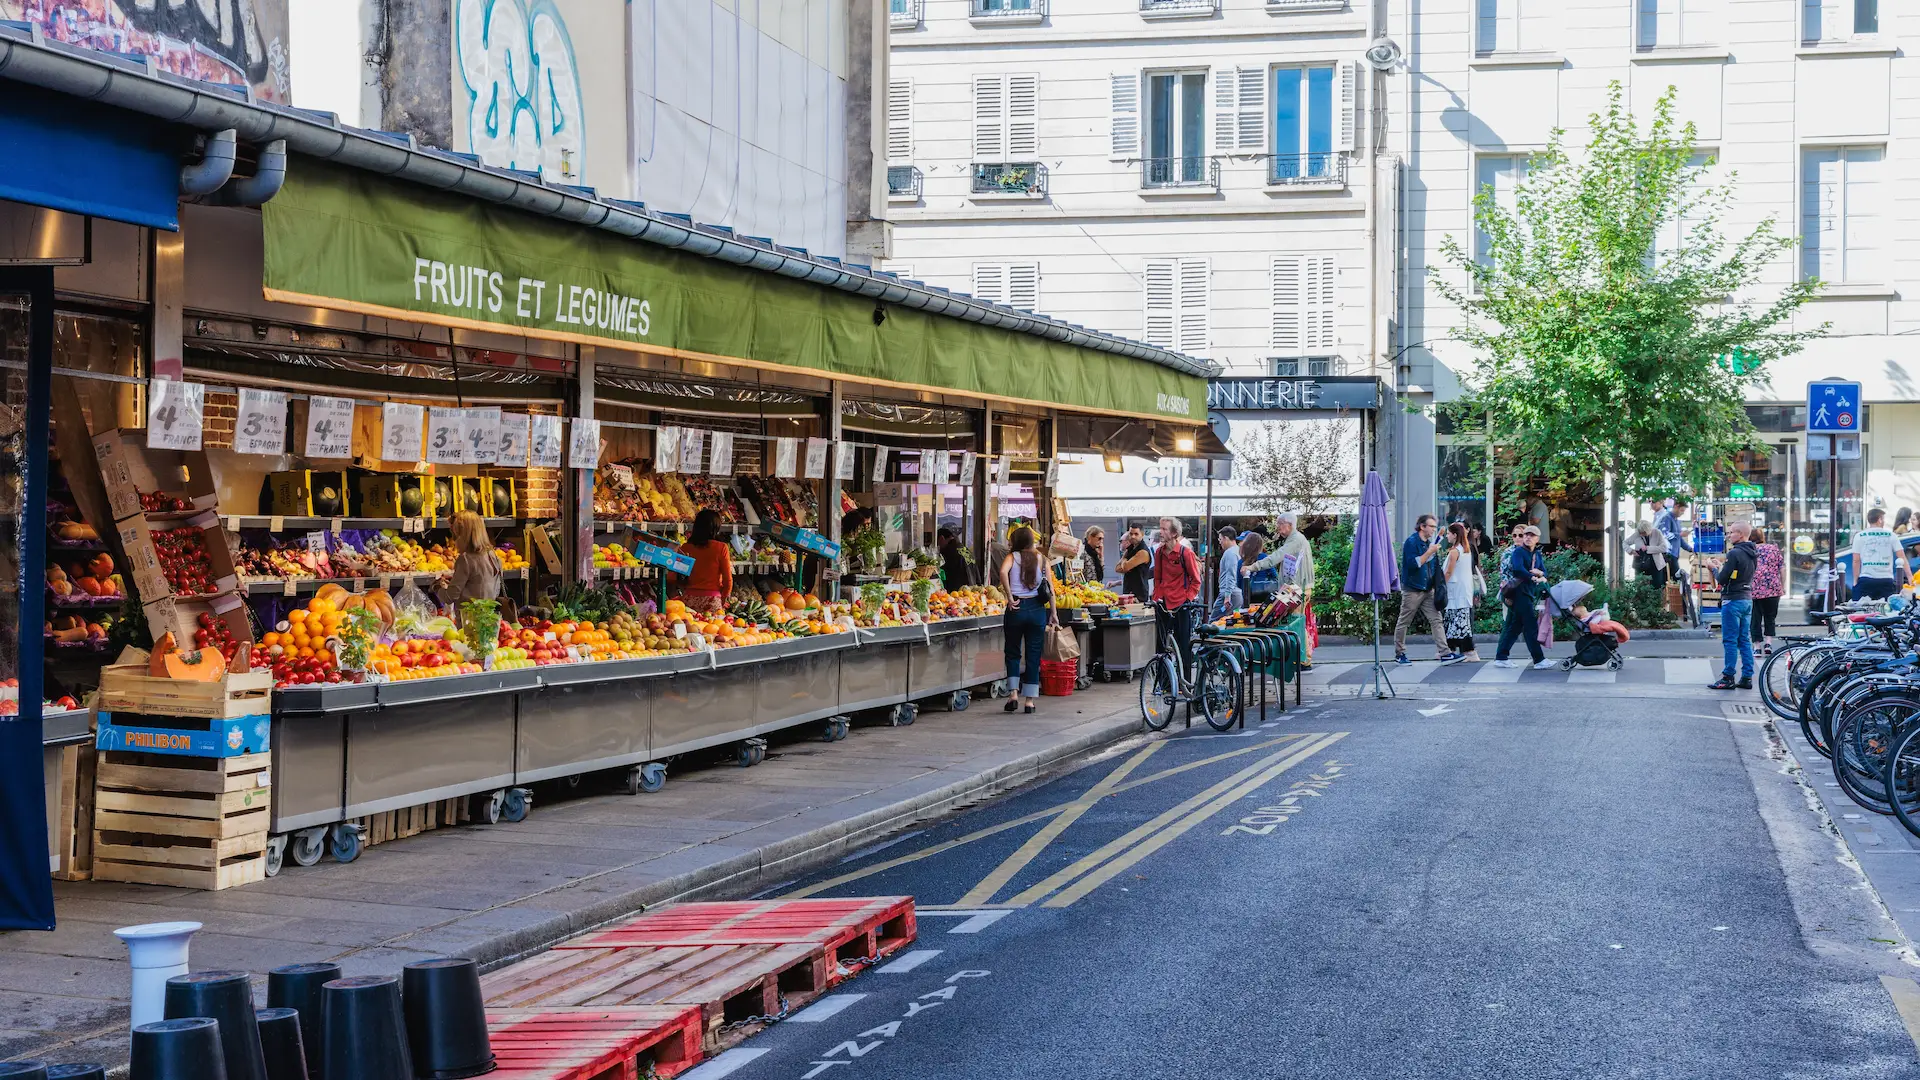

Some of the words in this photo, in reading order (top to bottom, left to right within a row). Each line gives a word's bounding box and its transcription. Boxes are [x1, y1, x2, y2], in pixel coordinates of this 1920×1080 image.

[414, 257, 503, 313] FRUITS
[517, 277, 546, 319] ET
[555, 284, 651, 336] LEGUMES
[156, 405, 179, 431] 4
[243, 412, 264, 436] 3
[163, 434, 198, 445] FRANCE
[314, 419, 333, 441] 4
[387, 424, 404, 446] 3
[432, 427, 449, 448] 3
[468, 428, 483, 448] 4
[249, 439, 281, 449] ESPAGNE
[319, 444, 348, 454] FRANCE
[500, 432, 514, 452] 5
[534, 434, 547, 454] 3
[393, 448, 419, 458] FRANCE
[438, 449, 461, 459] FRANCE
[125, 731, 191, 750] PHILIBON
[800, 969, 992, 1080] PAYANT
